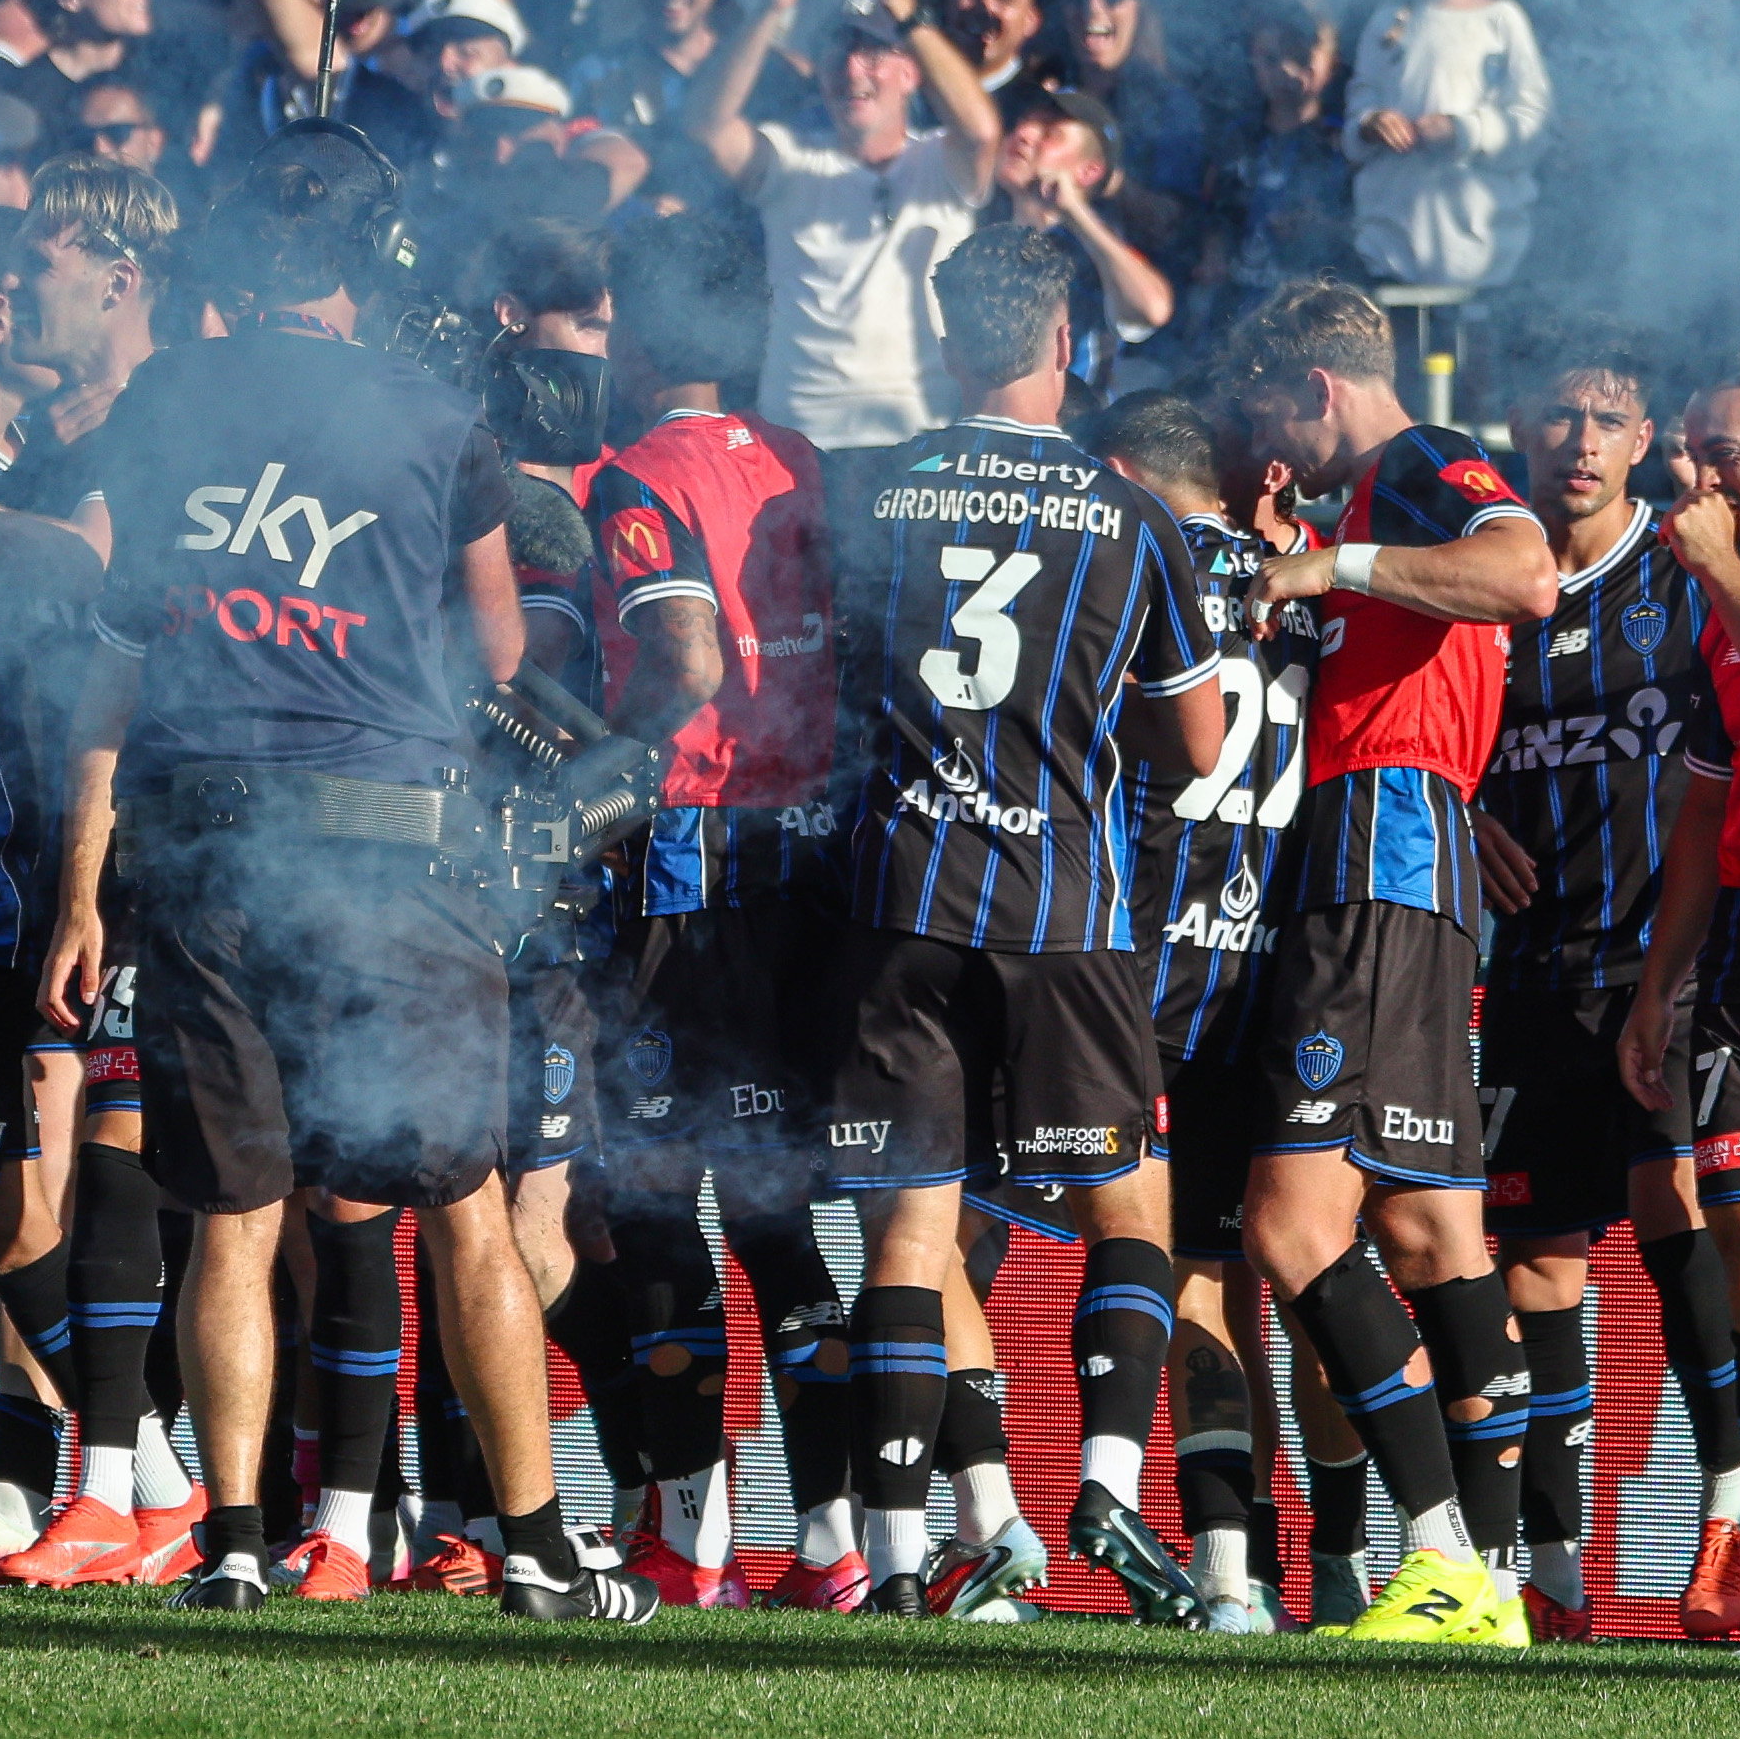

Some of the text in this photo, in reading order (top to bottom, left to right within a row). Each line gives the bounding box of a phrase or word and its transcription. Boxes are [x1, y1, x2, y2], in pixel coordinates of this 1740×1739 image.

[955, 454, 1099, 490] Liberty
[873, 487, 1122, 540] GIRDWOOD-REICH
[162, 583, 368, 659] SPORT
[918, 546, 1043, 710] 3
[1489, 713, 1608, 775] ANZ
[894, 778, 1049, 836] Anchor
[1015, 1140, 1106, 1156] THOMPSON
[1035, 1127, 1106, 1142] BARFOOT
